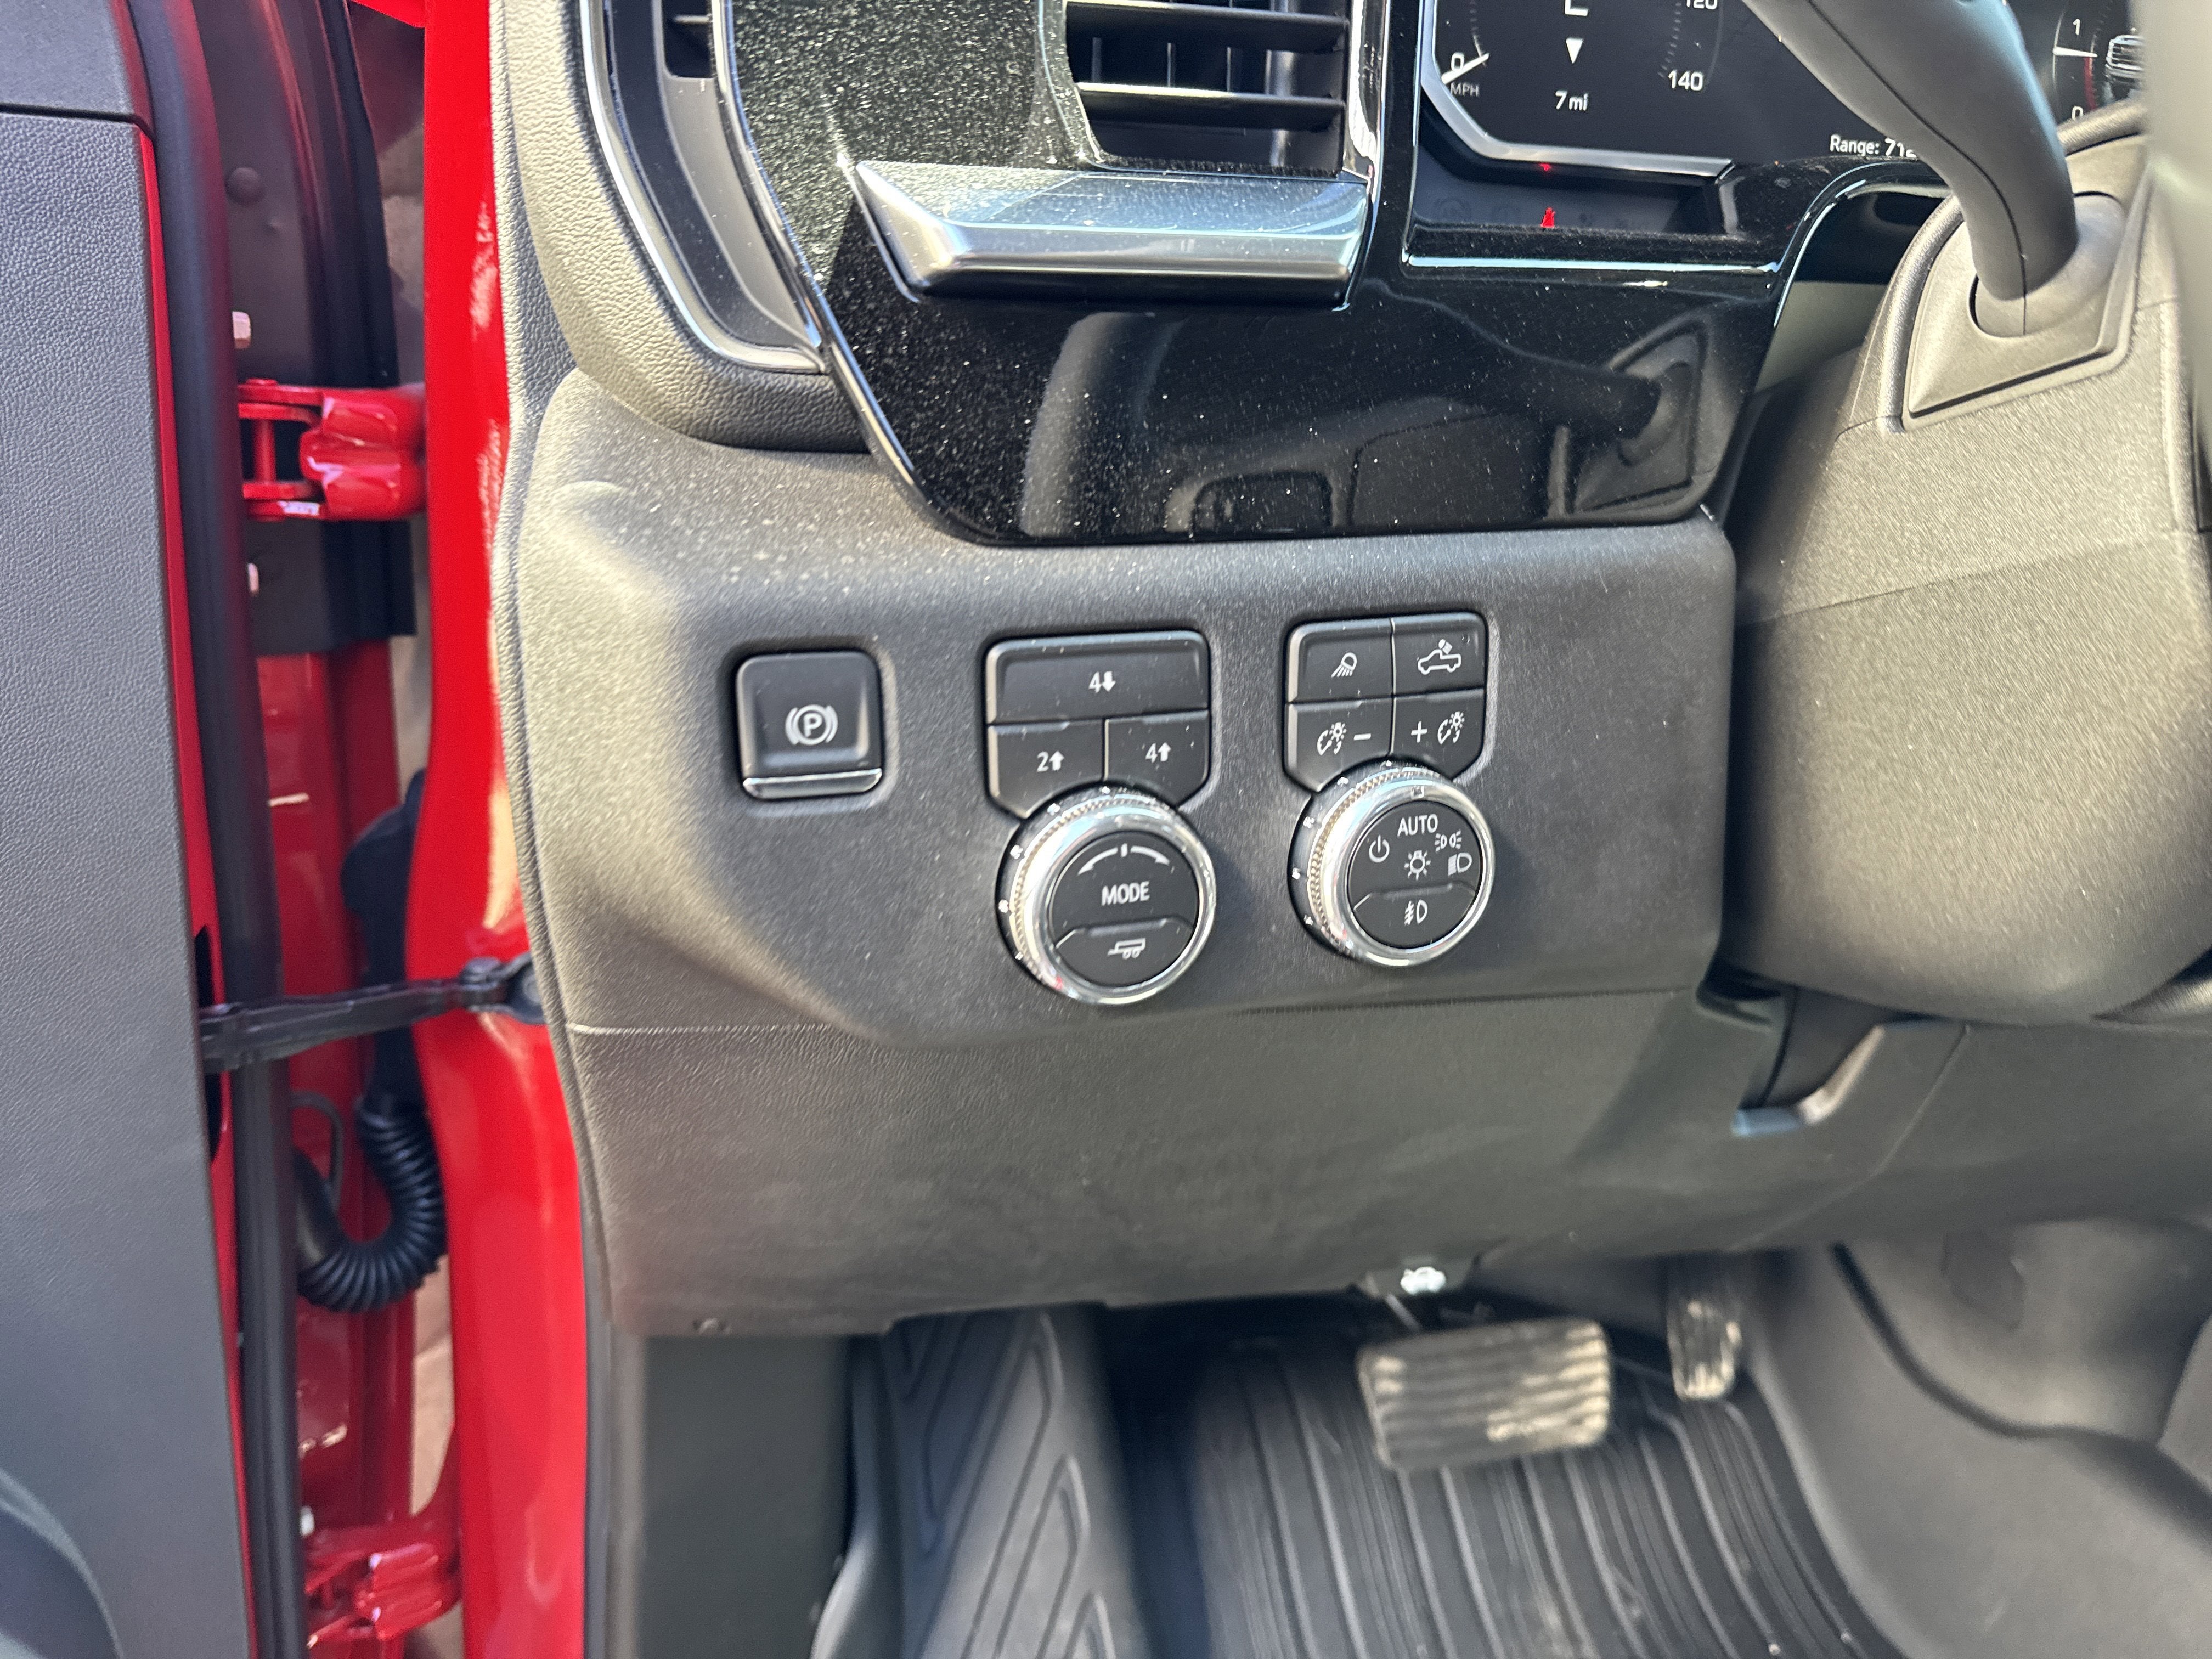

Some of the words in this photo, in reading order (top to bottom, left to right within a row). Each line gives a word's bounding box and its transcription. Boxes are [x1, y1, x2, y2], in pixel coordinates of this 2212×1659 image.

[2073, 19, 2080, 36] 1
[1451, 52, 1464, 71] 0
[1451, 82, 1480, 97] MPH
[1668, 70, 1703, 91] 140
[1555, 91, 1567, 110] 7
[1568, 93, 1589, 111] mi
[1830, 134, 1880, 157] Range:
[1088, 671, 1102, 693] 4
[1036, 751, 1049, 772] 2
[1145, 743, 1158, 763] 4
[1397, 814, 1438, 838] AUTO
[1102, 881, 1150, 906] MODE
